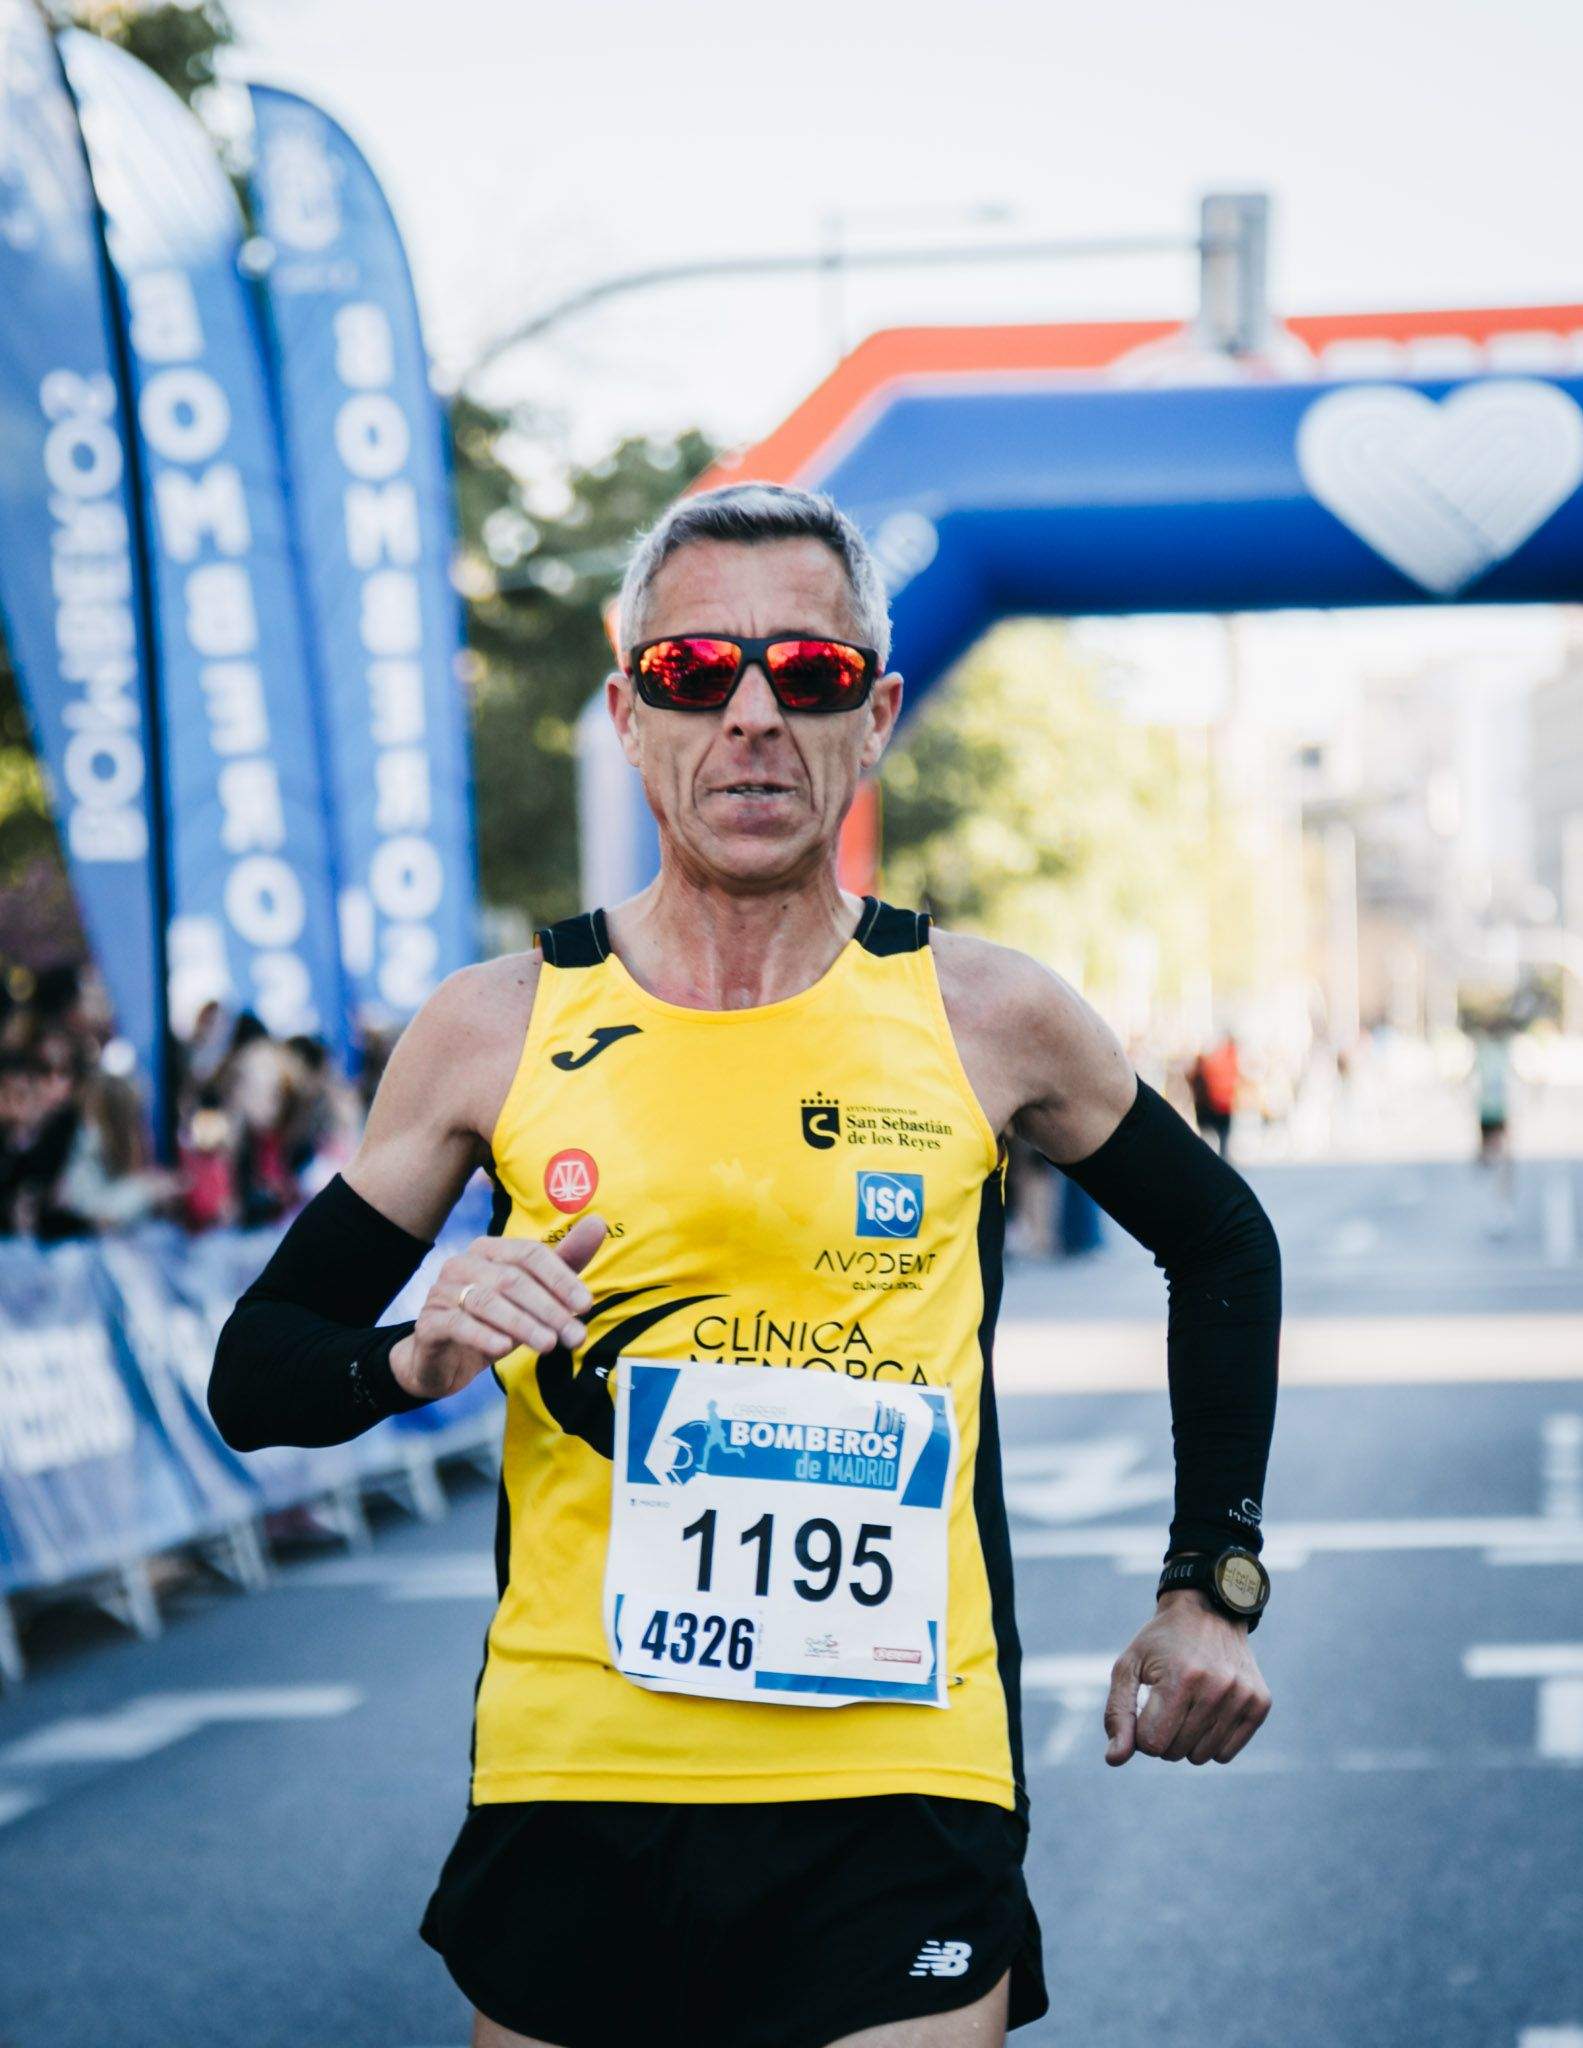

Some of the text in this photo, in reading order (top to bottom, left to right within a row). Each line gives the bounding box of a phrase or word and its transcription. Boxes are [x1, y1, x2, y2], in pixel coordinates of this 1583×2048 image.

[846, 1115, 953, 1136] San Sebastián
[847, 1130, 941, 1151] de los Reyes
[865, 1186, 916, 1223] ISC
[814, 1249, 936, 1275] AVODENT
[693, 1310, 873, 1354] CLÍNICA
[730, 1420, 899, 1460] BOMBEROS
[795, 1451, 896, 1487] de MADRID
[682, 1508, 894, 1608] 1195
[640, 1610, 755, 1672] 4326
